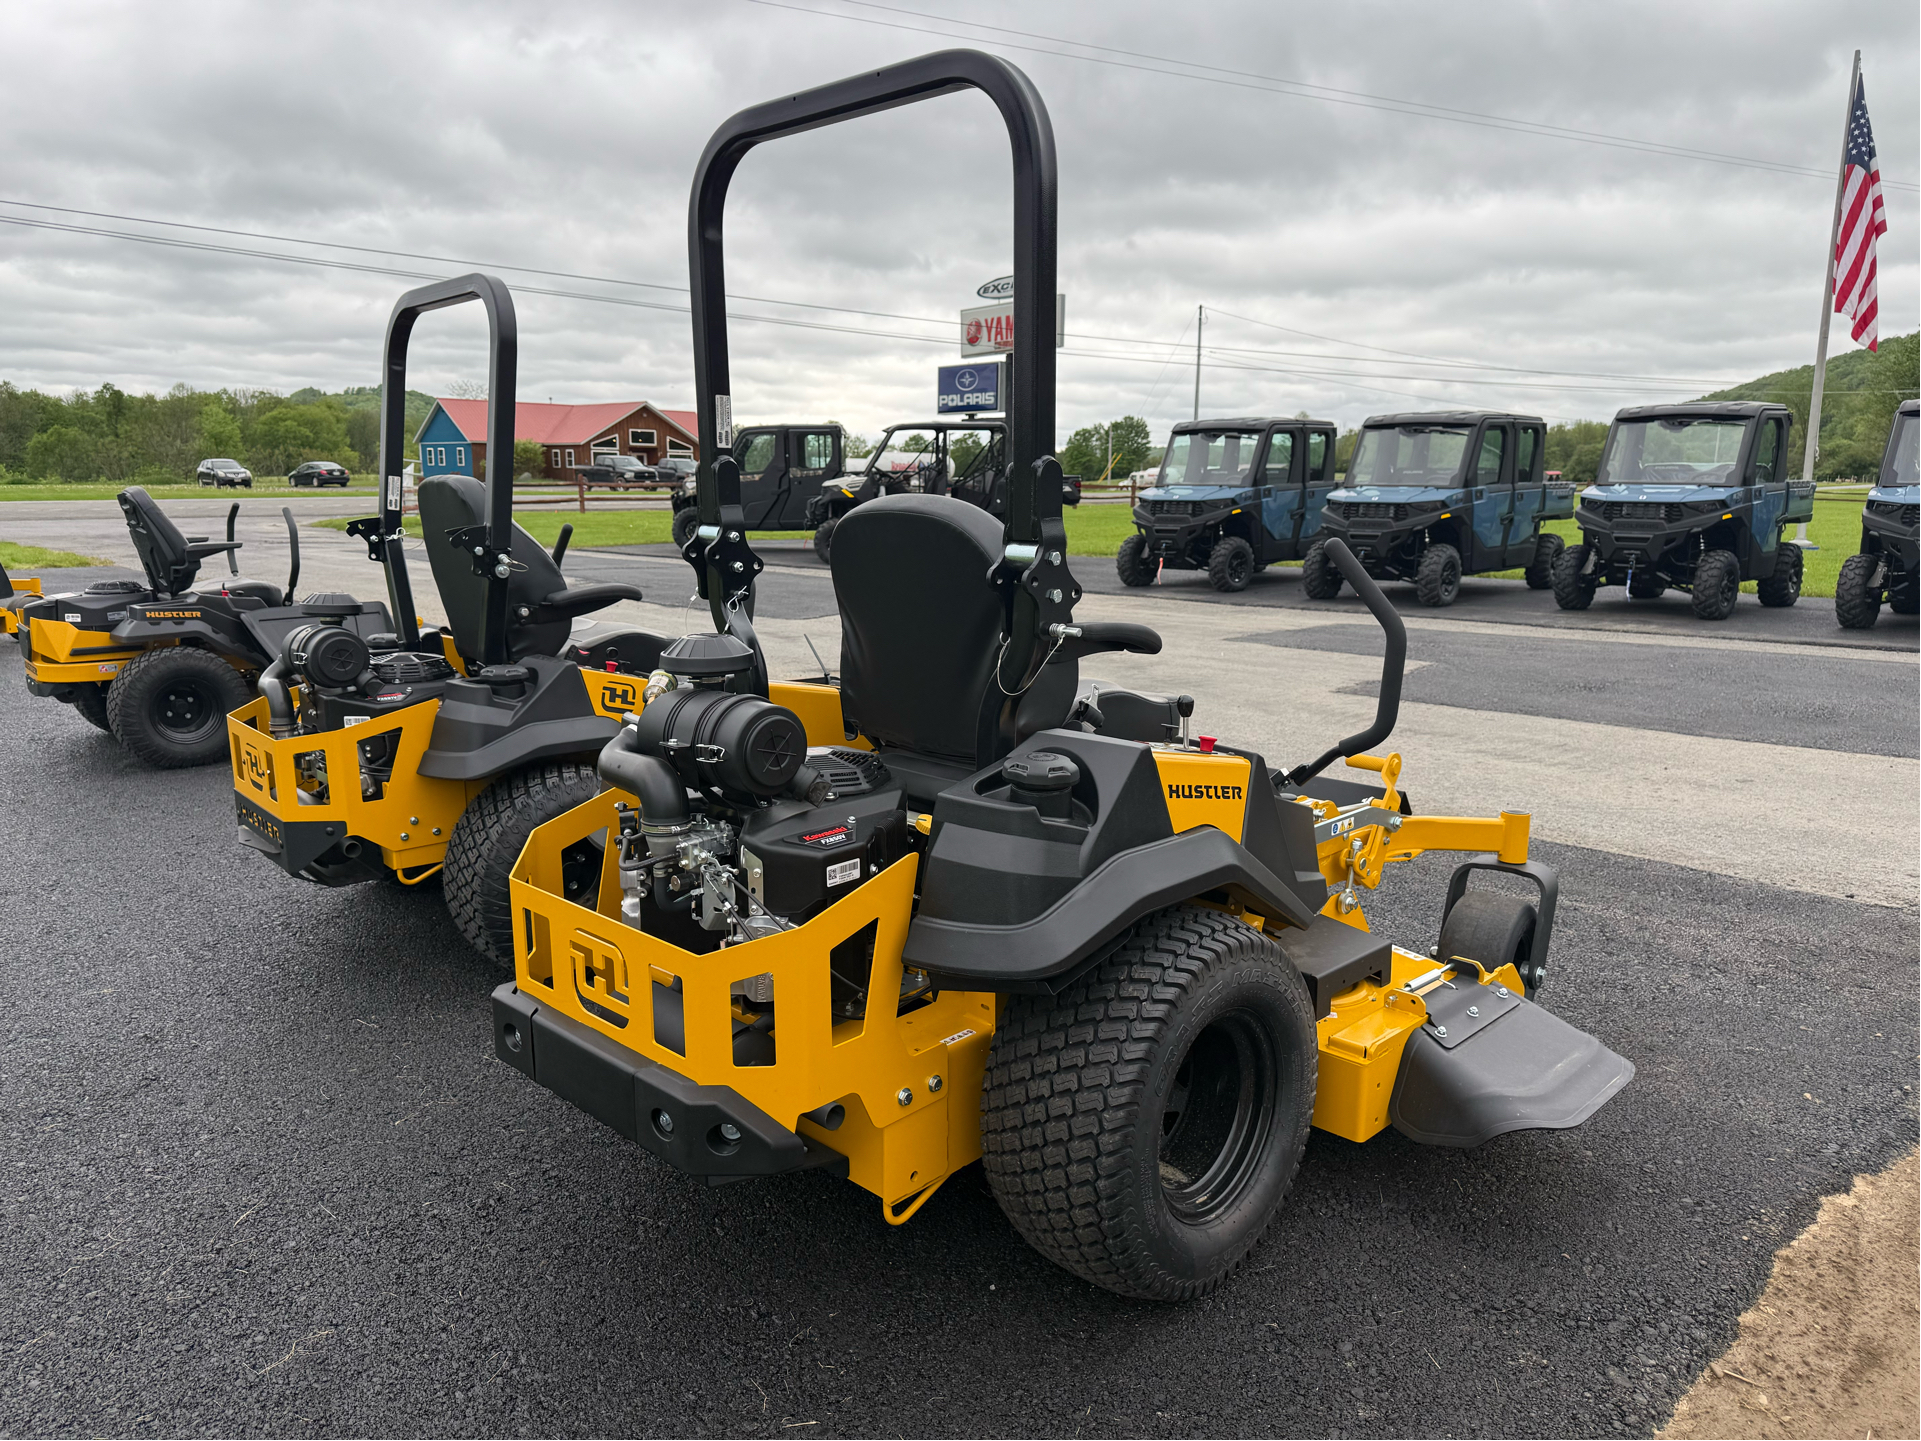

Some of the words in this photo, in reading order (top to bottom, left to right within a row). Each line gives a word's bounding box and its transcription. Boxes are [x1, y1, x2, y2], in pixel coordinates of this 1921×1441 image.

[939, 392, 995, 407] POLARIS
[1168, 784, 1243, 800] HUSTLER
[241, 803, 283, 843] HUSTLER
[802, 826, 848, 842] Kawasaki
[1232, 968, 1303, 1020] MASTER
